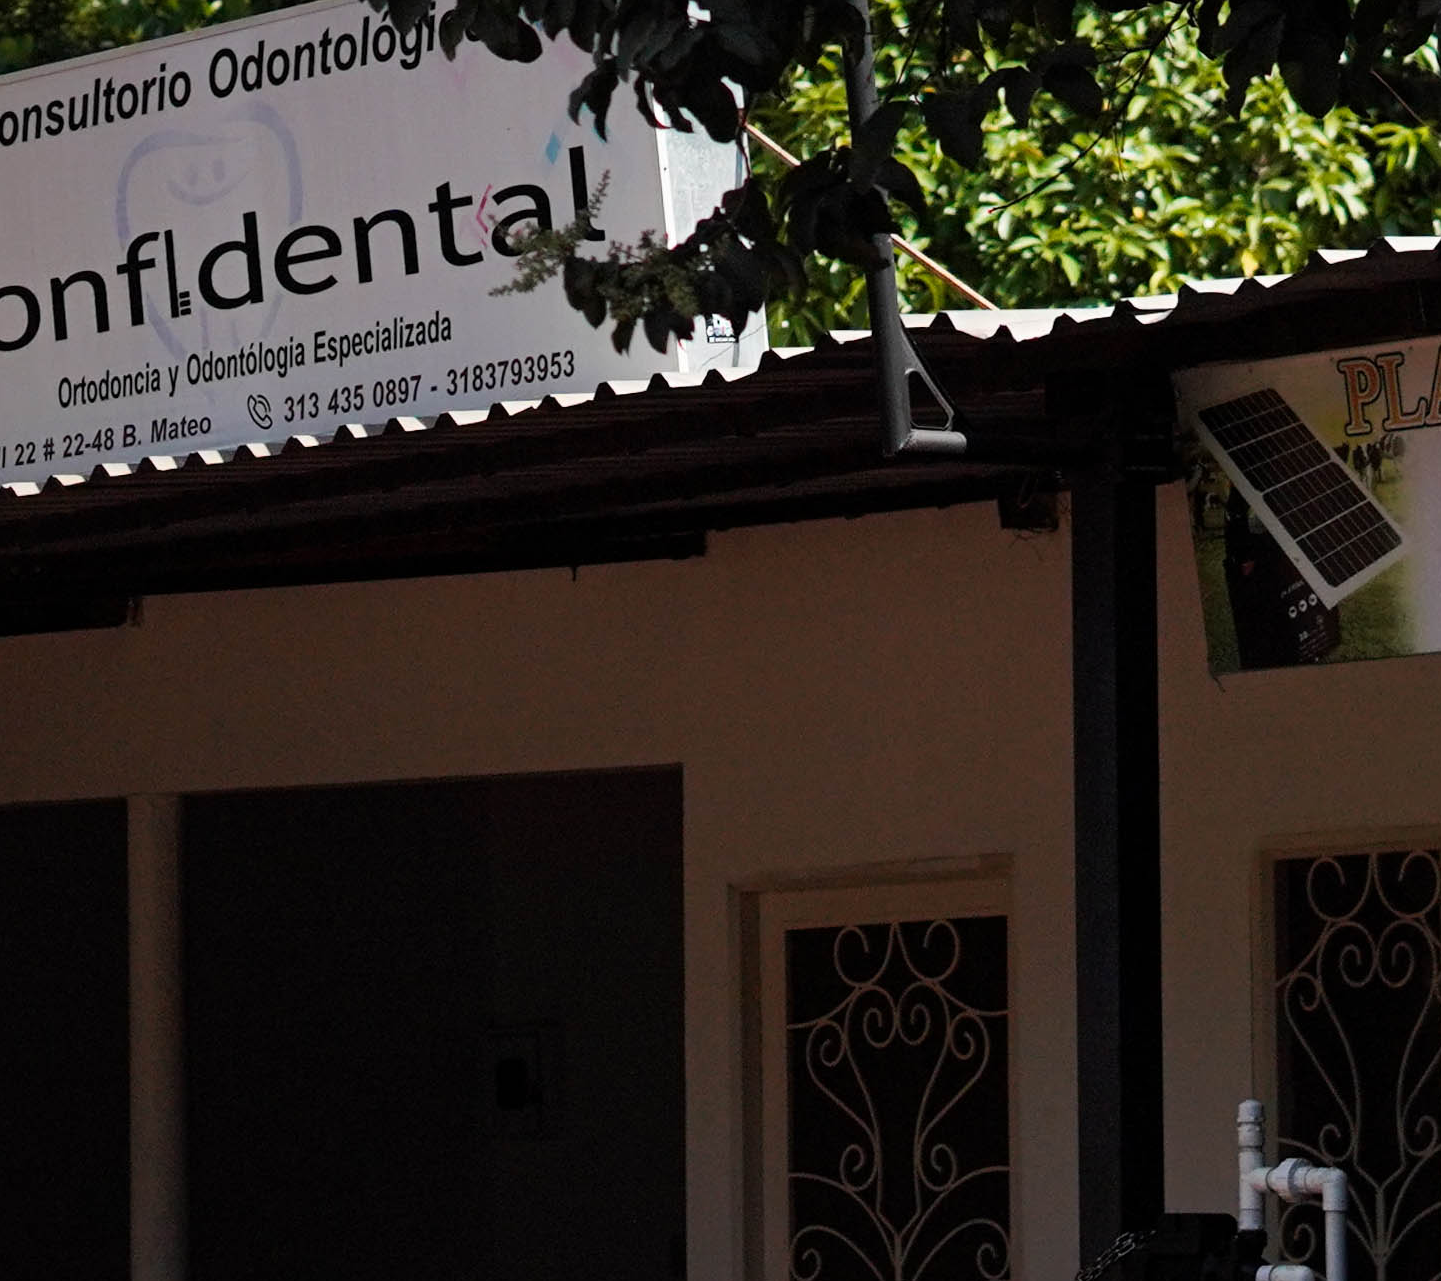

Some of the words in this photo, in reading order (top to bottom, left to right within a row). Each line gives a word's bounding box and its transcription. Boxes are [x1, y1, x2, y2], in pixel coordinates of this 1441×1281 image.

[209, 1, 481, 98] Odontológi
[58, 363, 161, 408] Ortodoncia
[168, 363, 180, 397] y
[313, 310, 453, 364] Especializada
[284, 396, 320, 422] 313
[327, 385, 364, 413] 435
[372, 375, 422, 407] 0897
[446, 350, 576, 396] 3183793953
[15, 442, 36, 467] 22
[42, 438, 56, 461] #
[62, 427, 115, 458] 22-48
[122, 424, 143, 448] B.
[151, 416, 212, 444] Mateo
